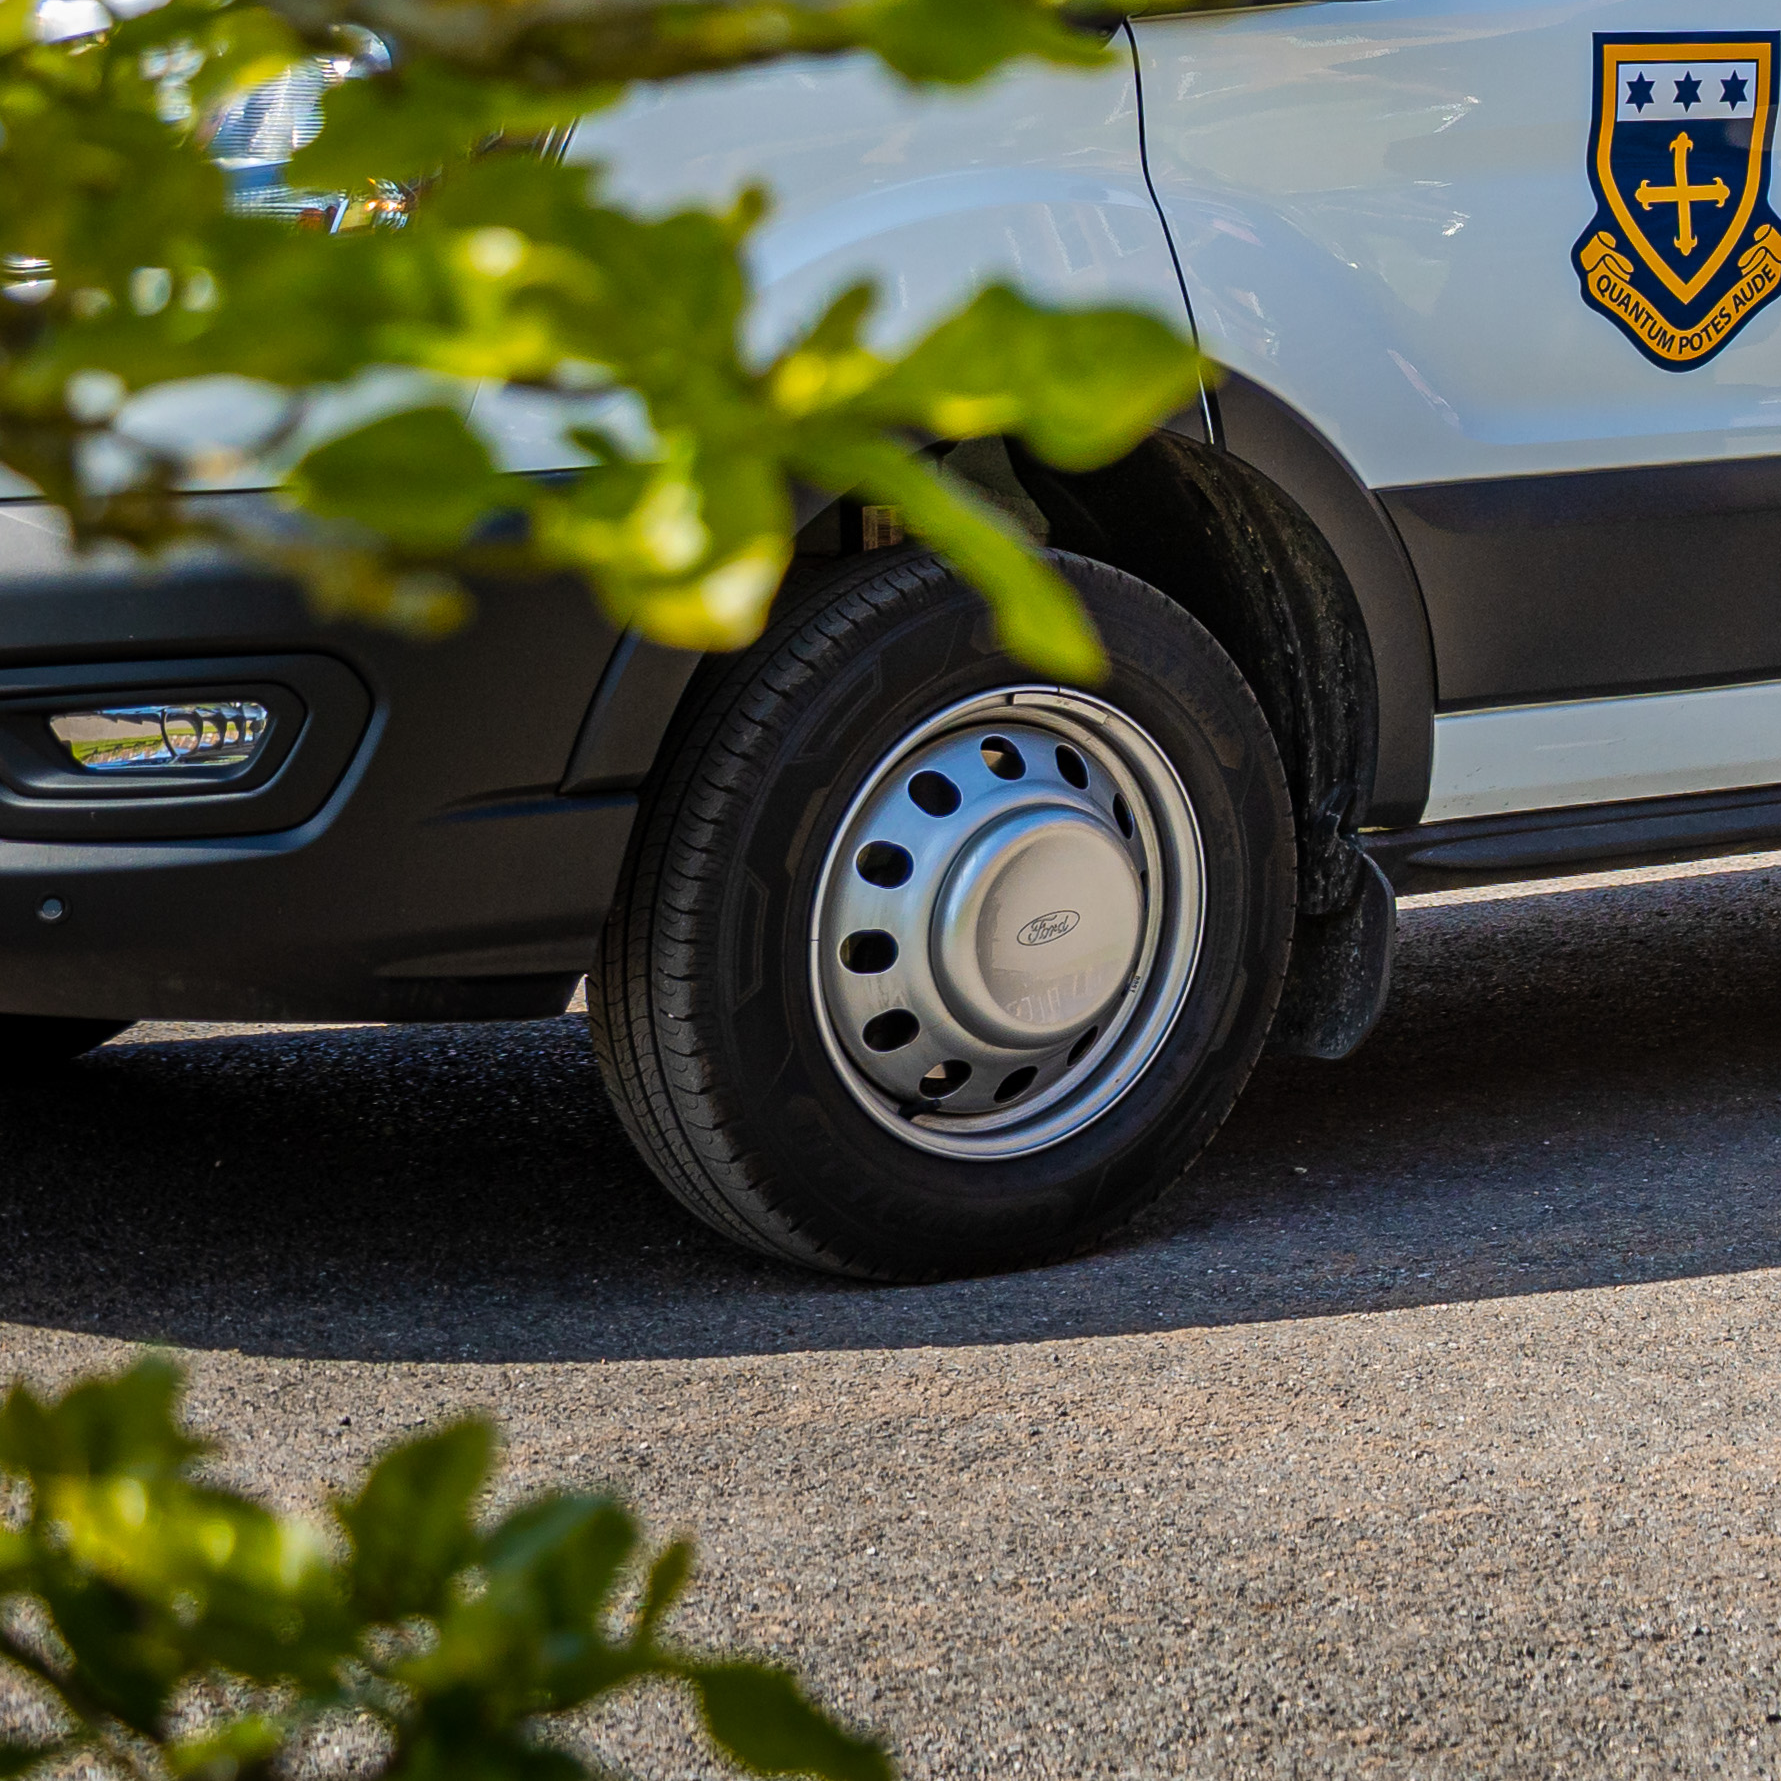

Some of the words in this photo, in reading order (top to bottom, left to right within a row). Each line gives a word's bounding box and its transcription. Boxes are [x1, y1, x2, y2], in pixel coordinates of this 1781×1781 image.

[1596, 274, 1675, 353] QUANTUM
[1678, 306, 1732, 354] POTES
[1732, 264, 1776, 313] AUDE
[1026, 913, 1071, 945] Ford
